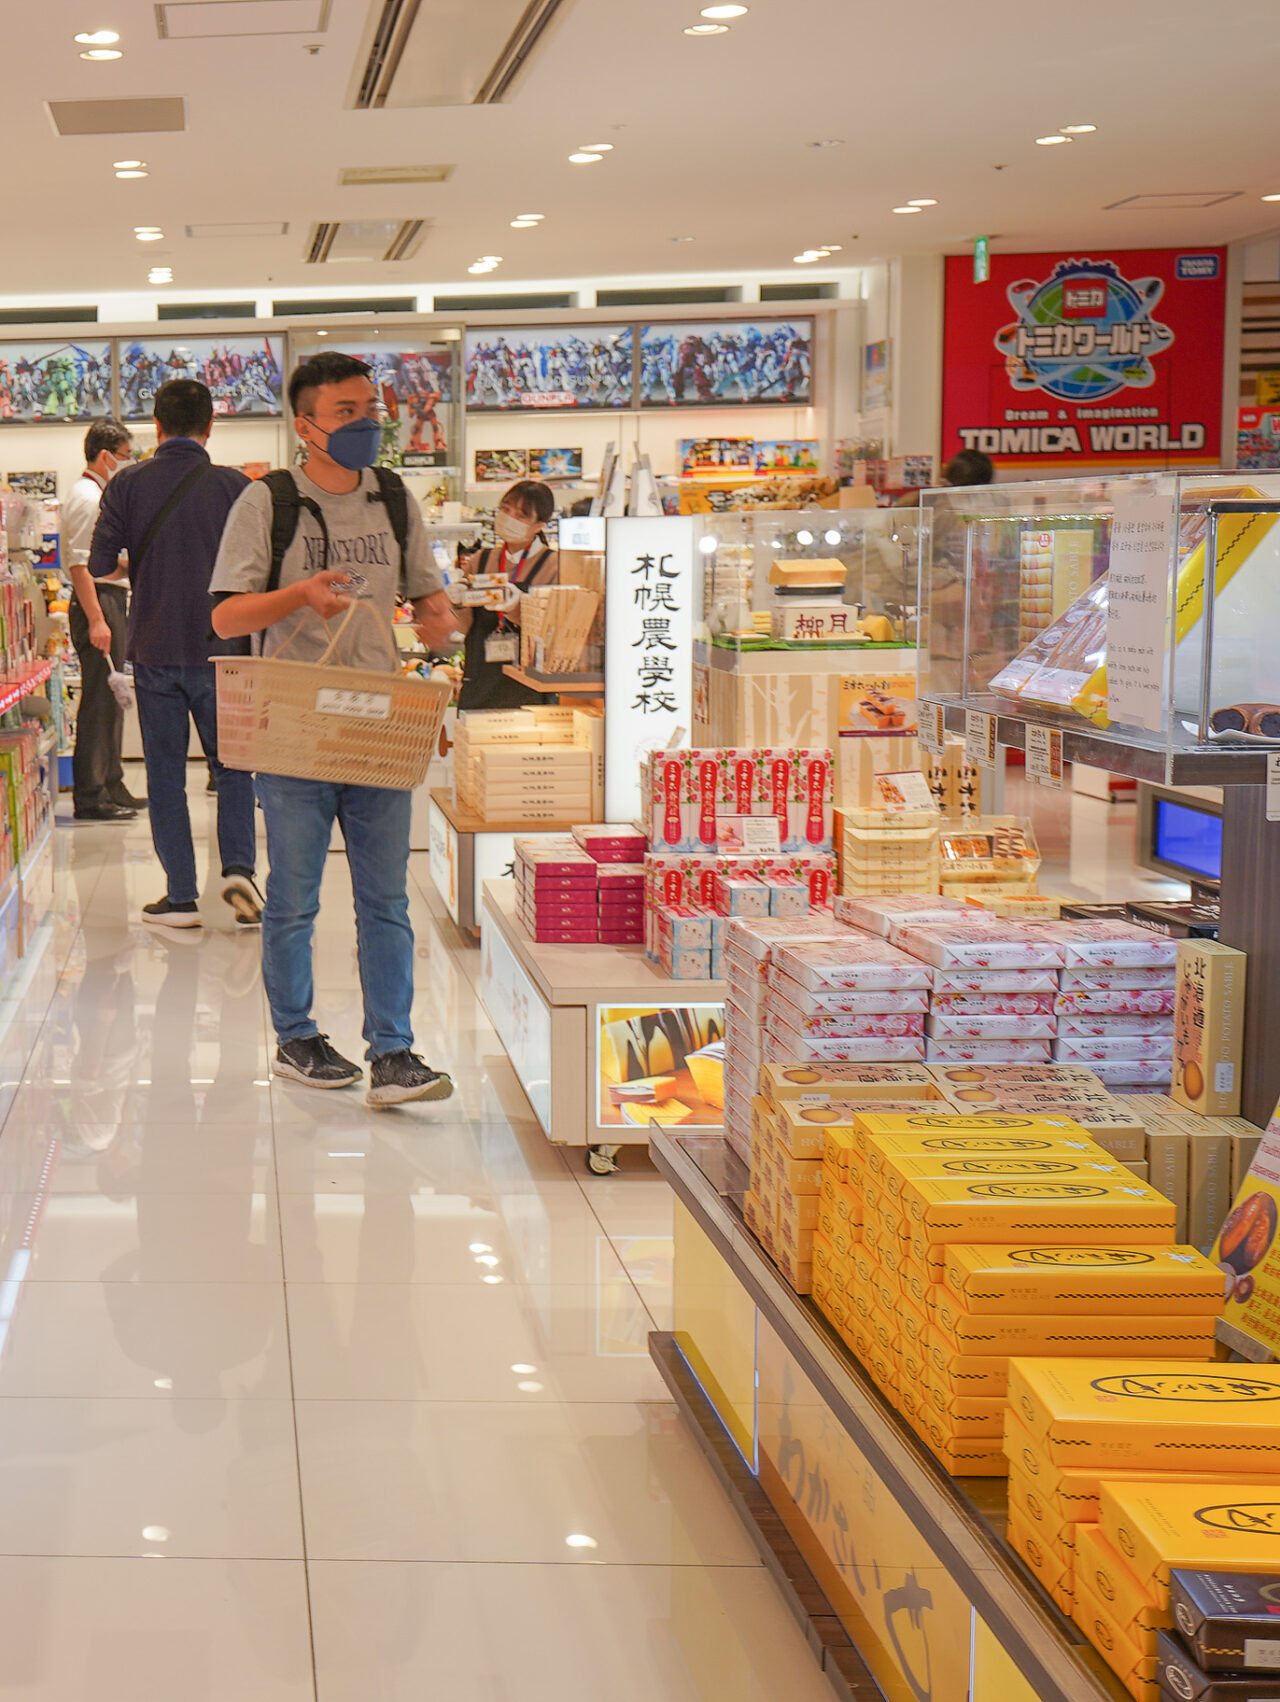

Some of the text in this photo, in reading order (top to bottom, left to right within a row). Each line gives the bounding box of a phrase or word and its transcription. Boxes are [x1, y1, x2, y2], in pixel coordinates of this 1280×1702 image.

[1066, 289, 1105, 308] トミカ
[1017, 322, 1152, 358] トミカワールド
[1005, 409, 1049, 421] Dream
[1076, 407, 1159, 421] Imagination
[959, 423, 1206, 455] TOMICA WORLD
[630, 553, 681, 715] 札幌農學校
[795, 613, 848, 639] 柳月
